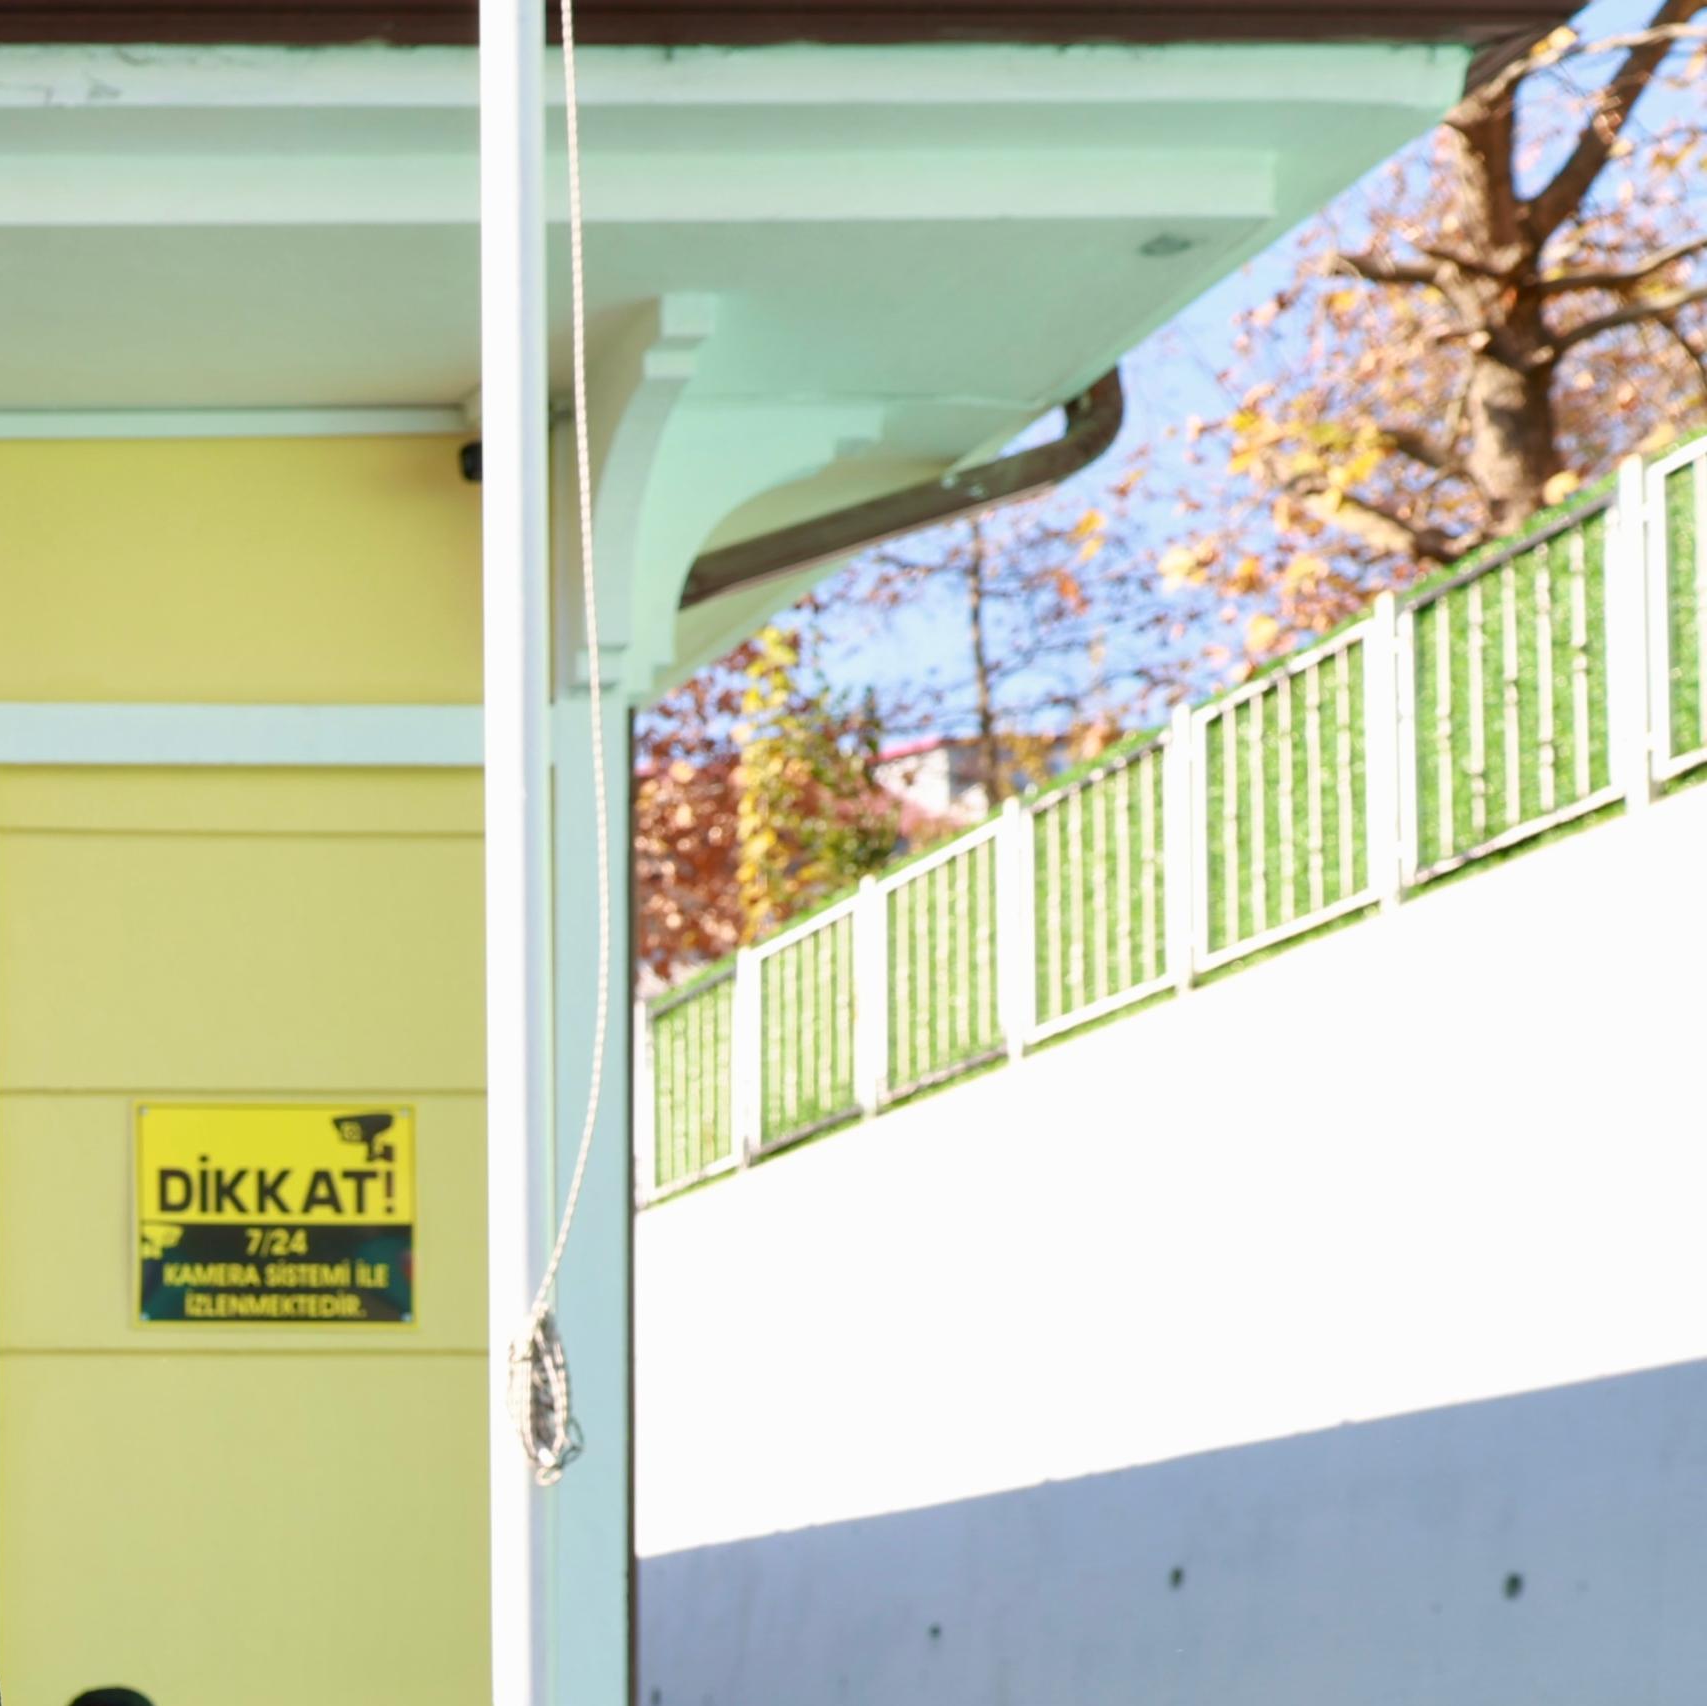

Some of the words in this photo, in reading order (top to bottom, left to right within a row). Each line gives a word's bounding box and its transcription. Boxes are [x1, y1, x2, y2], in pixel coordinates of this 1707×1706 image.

[158, 1154, 394, 1215] DİKKAT!
[245, 1228, 309, 1257] 7/24
[163, 1261, 262, 1287] KAMERA
[264, 1257, 352, 1287] SİSTEMİ
[355, 1257, 389, 1288] İLE
